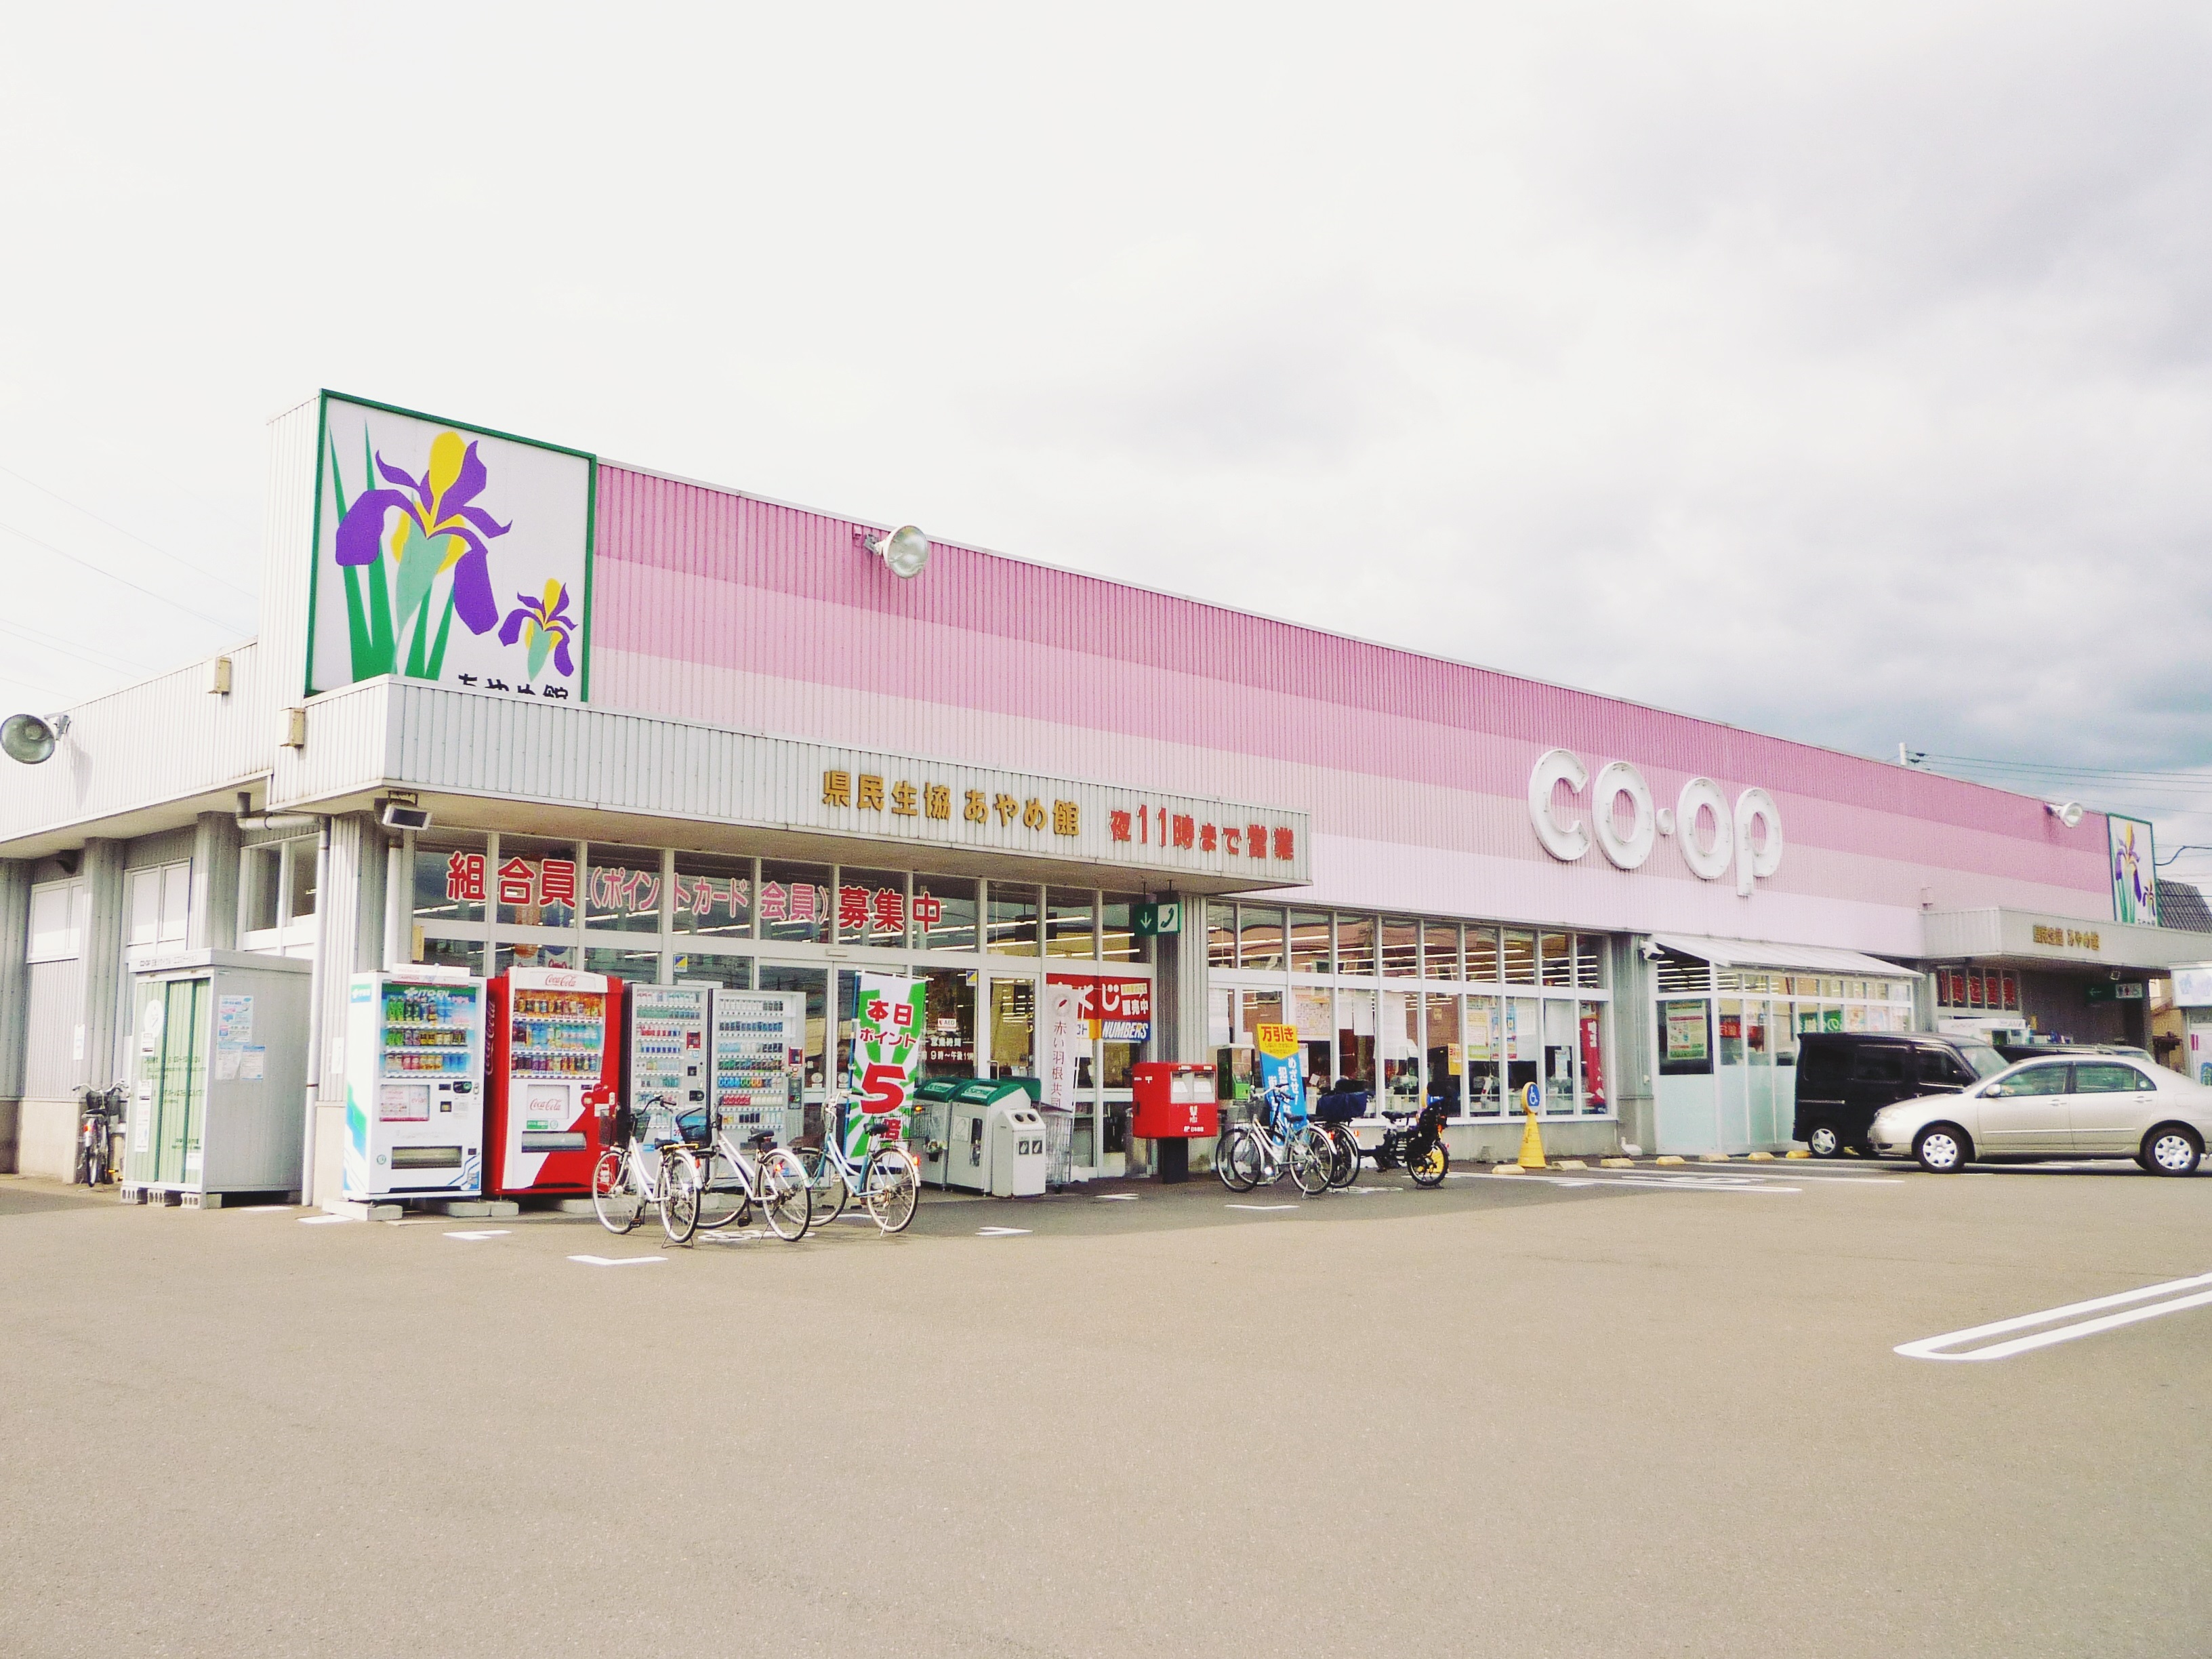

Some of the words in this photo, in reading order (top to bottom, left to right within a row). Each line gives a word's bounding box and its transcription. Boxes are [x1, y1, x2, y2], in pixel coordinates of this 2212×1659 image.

[1109, 804, 1294, 861] 夜11時まで営業
[867, 1000, 913, 1026] 本日
[859, 1028, 917, 1048] ポイント
[1103, 1021, 1149, 1039] NUMBERS
[1261, 1026, 1294, 1042] 万引き
[861, 1063, 906, 1114] 5
